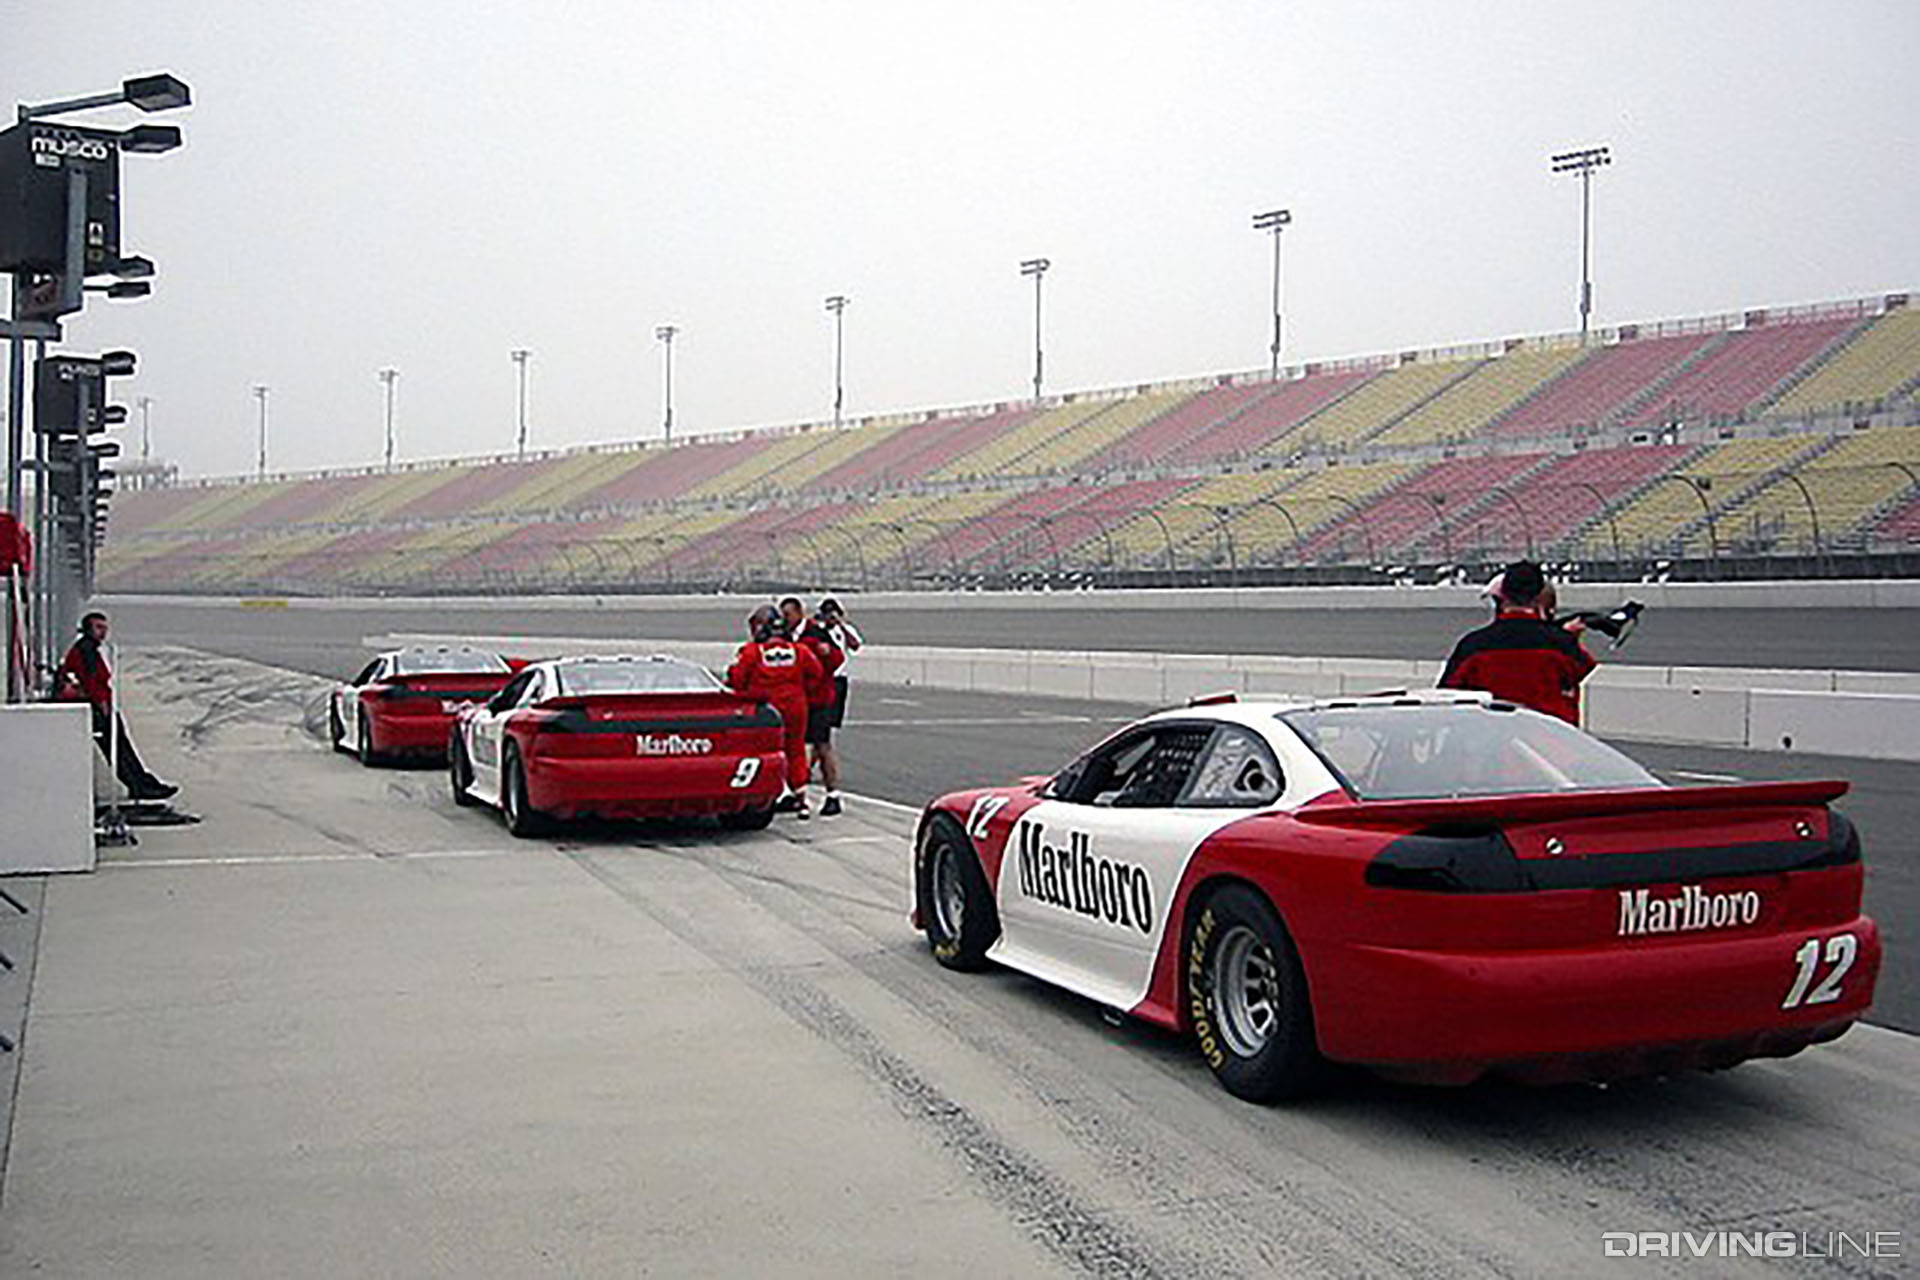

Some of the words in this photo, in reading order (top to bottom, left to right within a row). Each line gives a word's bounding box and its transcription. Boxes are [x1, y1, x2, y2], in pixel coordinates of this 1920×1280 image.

[636, 734, 713, 756] Marlboro
[730, 757, 761, 788] 9
[966, 795, 1009, 839] 12
[1019, 820, 1153, 934] Marlboro
[1618, 884, 1760, 936] Marlboro
[1781, 933, 1858, 1009] 12
